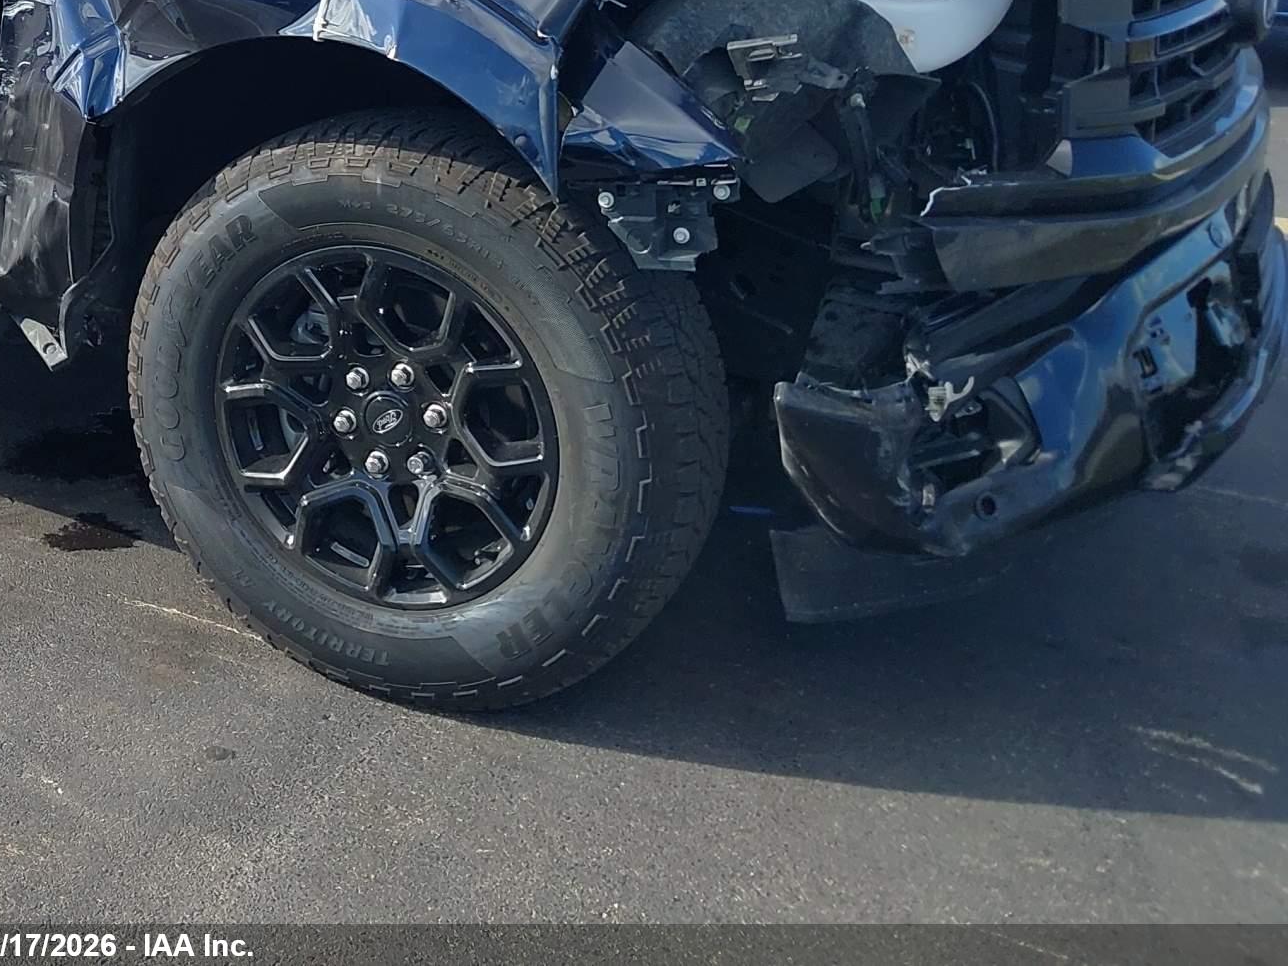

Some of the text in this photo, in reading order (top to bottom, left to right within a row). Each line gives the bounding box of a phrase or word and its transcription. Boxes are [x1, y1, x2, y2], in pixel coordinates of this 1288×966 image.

[154, 213, 258, 462] GOODYEAR
[263, 597, 391, 667] TERRITORY
[495, 401, 622, 660] WRANGLER
